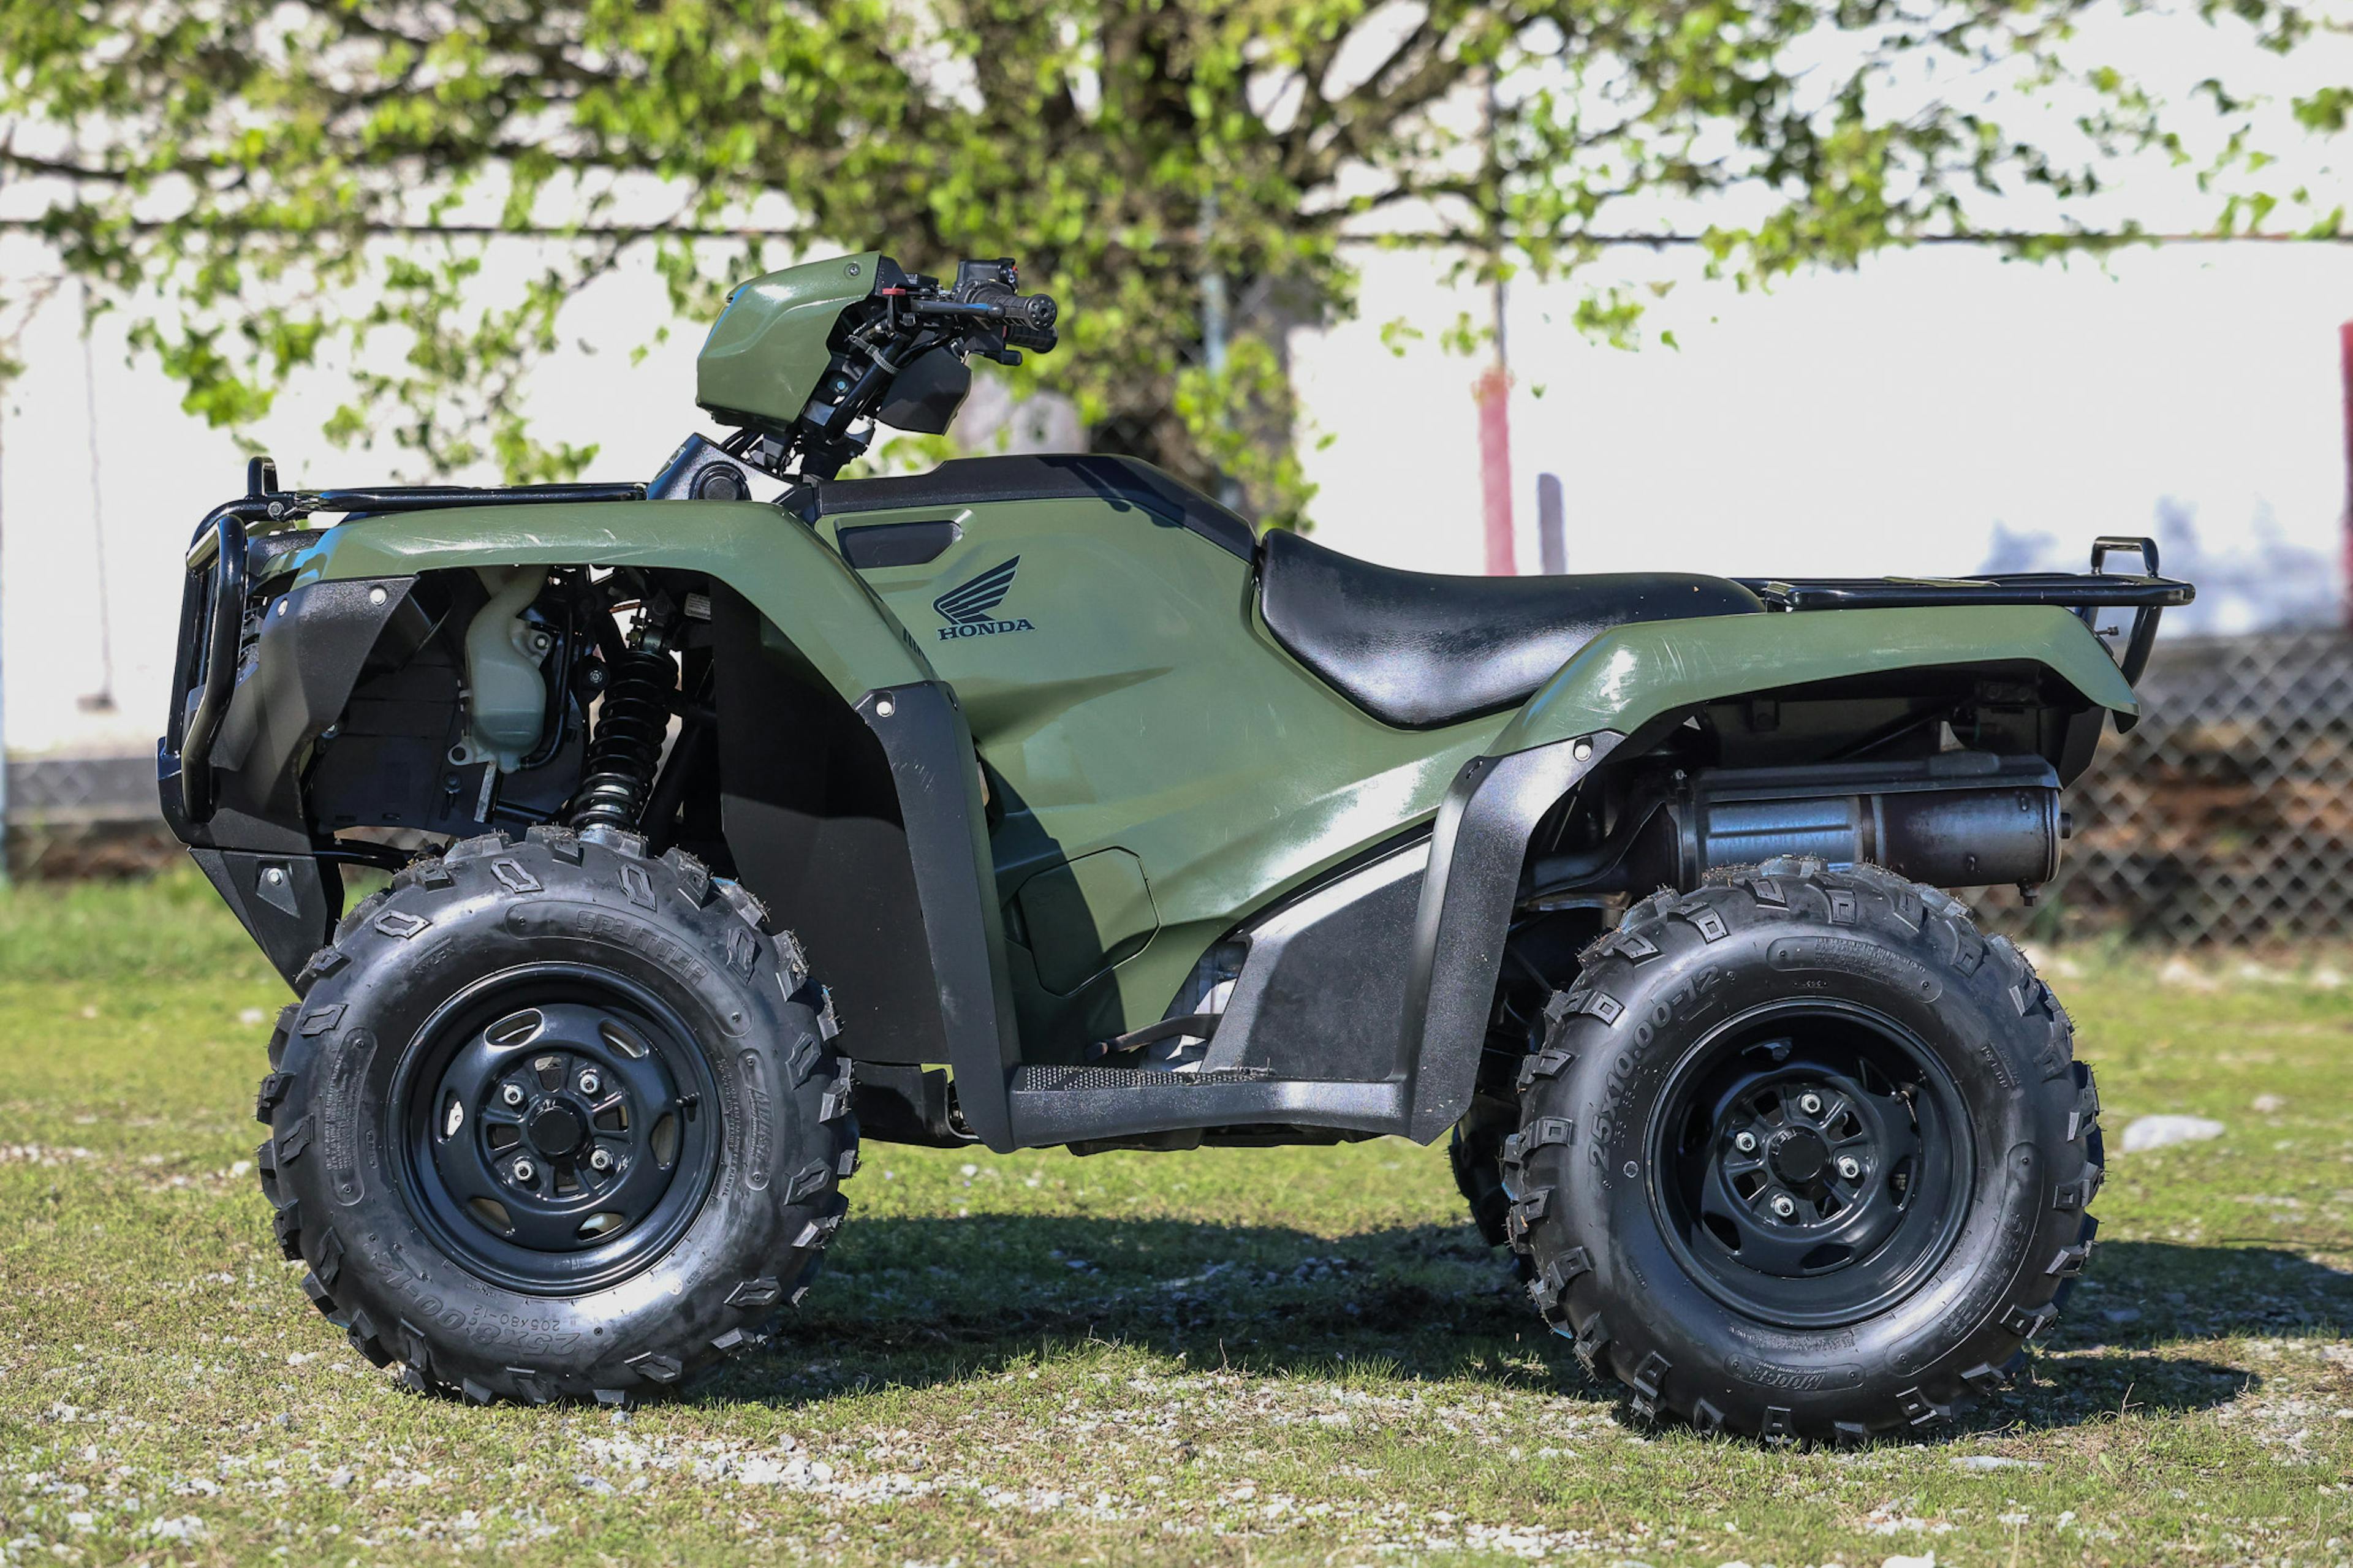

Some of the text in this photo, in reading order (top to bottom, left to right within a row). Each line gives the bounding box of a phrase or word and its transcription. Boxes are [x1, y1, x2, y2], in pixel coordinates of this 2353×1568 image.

[938, 619, 1036, 640] HONDA
[577, 911, 708, 986] SPLITTER
[1588, 964, 1721, 1172] 25x10.00-12
